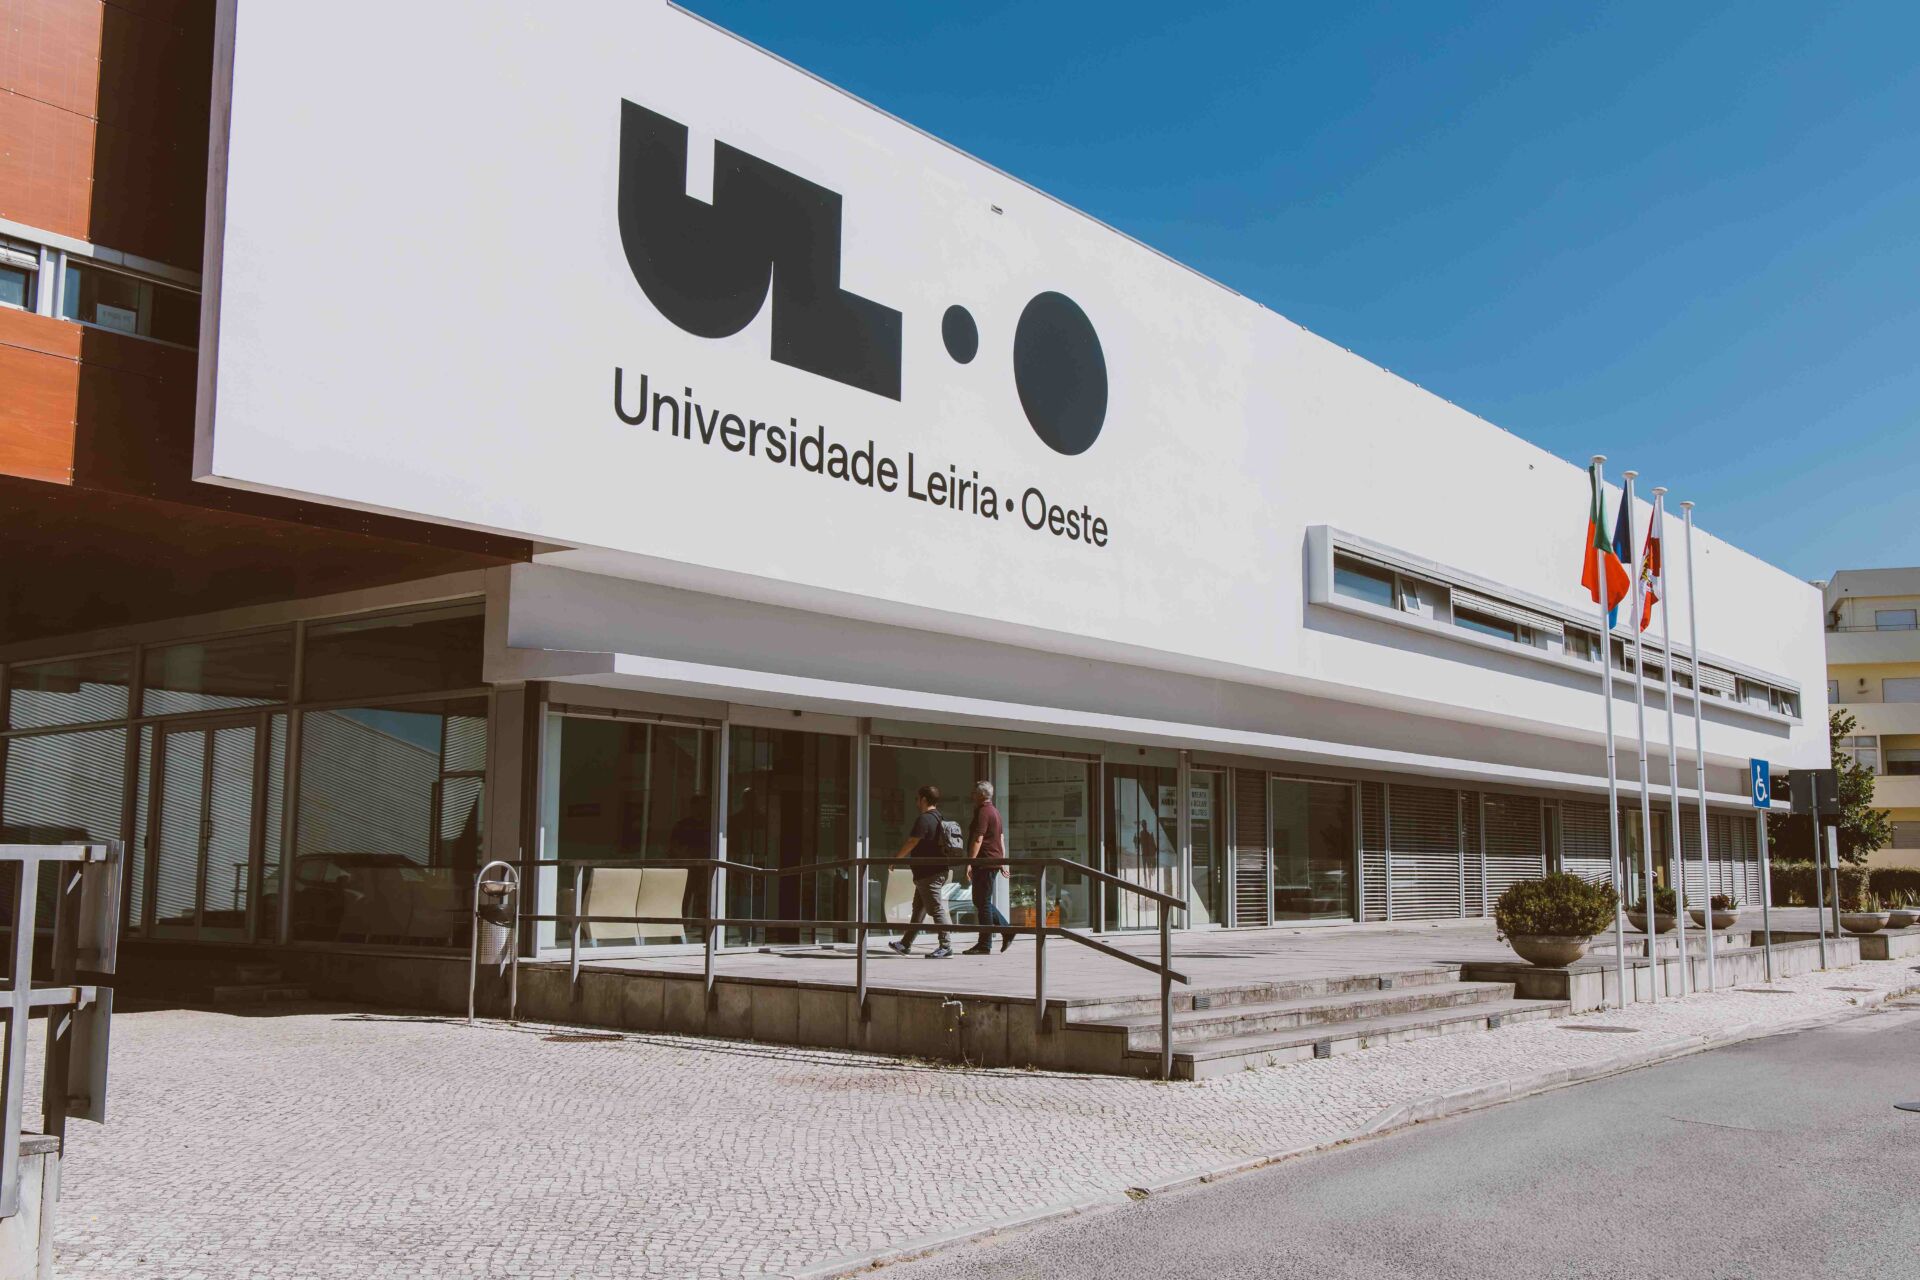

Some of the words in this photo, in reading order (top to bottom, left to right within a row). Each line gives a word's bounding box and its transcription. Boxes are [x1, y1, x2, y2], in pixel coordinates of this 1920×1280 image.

[614, 366, 898, 493] Universidade
[908, 452, 999, 521] Leiria
[1021, 487, 1108, 548] Oeste
